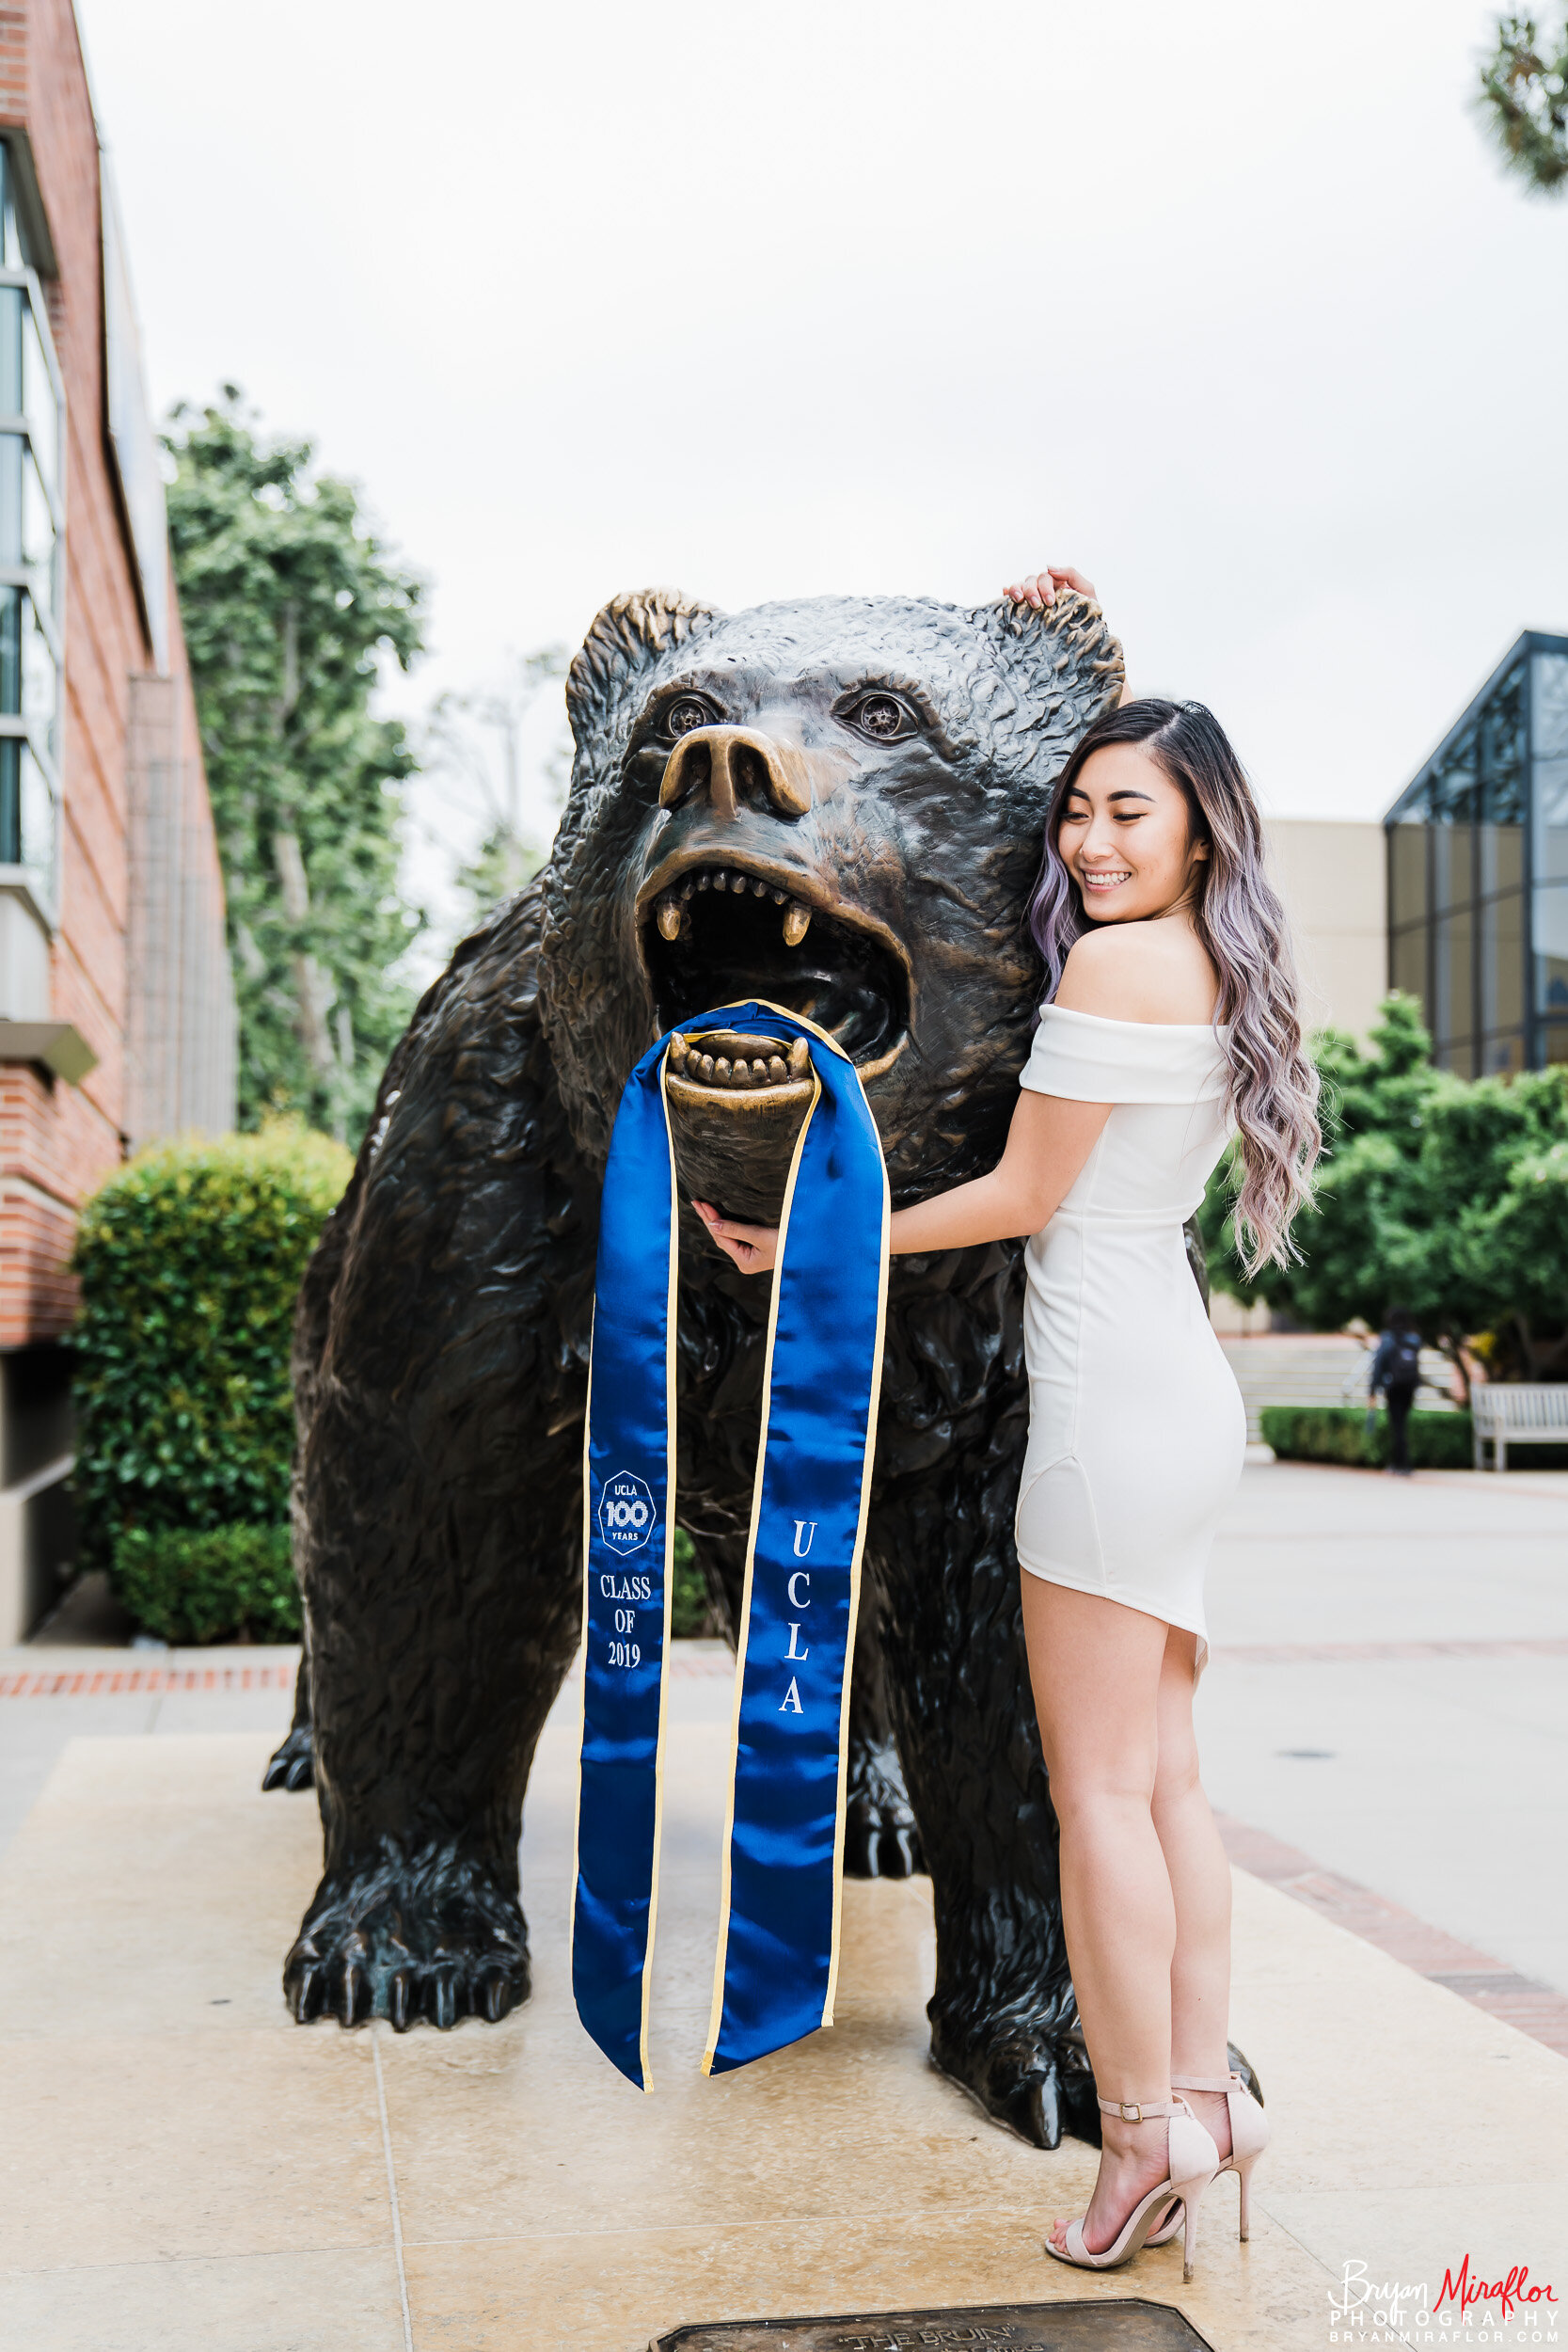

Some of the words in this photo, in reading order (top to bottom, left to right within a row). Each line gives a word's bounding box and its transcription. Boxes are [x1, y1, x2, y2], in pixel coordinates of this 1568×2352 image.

[614, 1485, 637, 1496] UCLA
[606, 1501, 649, 1527] 100
[611, 1532, 639, 1541] YEARS
[600, 1574, 651, 1600] CLASS
[614, 1609, 636, 1634] OF
[608, 1642, 641, 1668] 2019
